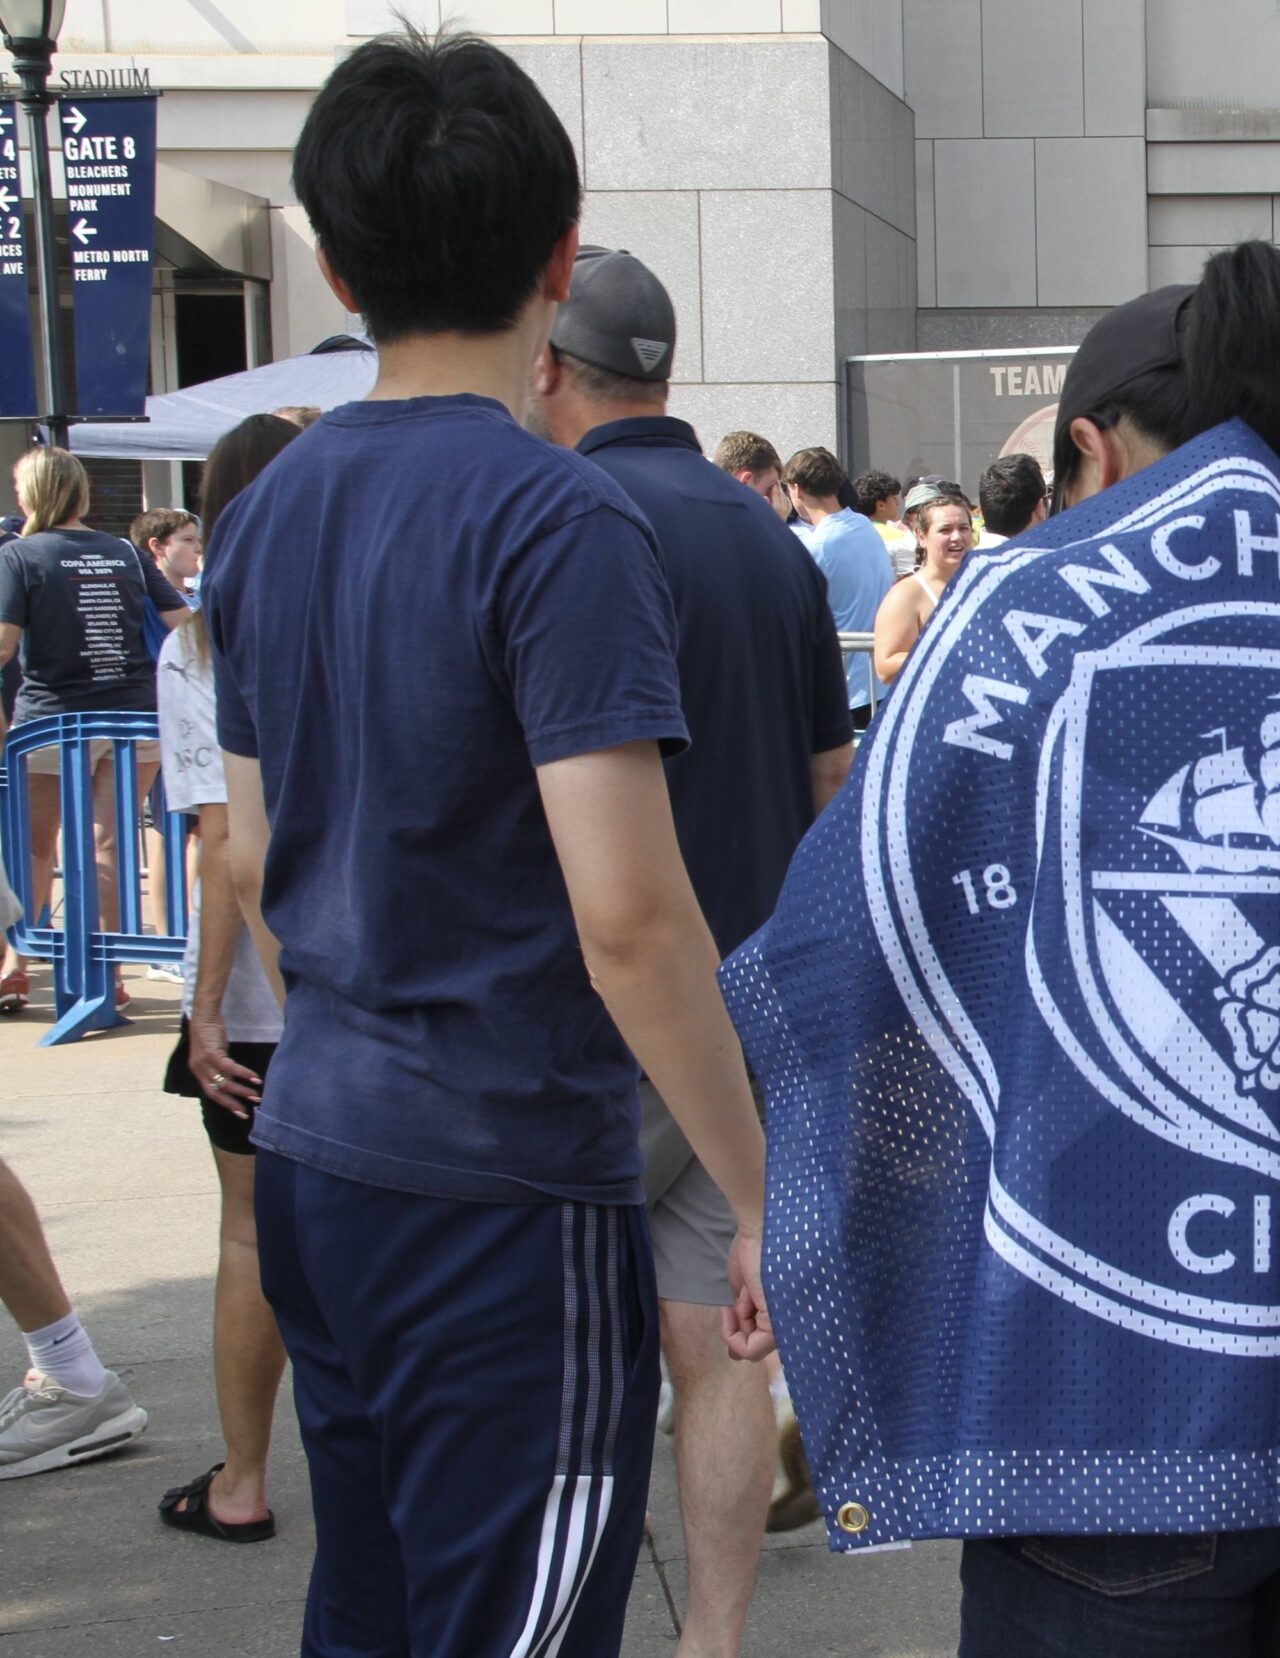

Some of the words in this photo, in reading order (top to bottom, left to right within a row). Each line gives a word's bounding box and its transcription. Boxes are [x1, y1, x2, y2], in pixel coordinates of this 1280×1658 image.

[60, 68, 152, 91] STADIUM
[3, 139, 16, 162] 4
[64, 136, 118, 160] GATE
[123, 136, 136, 160] 8
[67, 165, 128, 178] BLEACHERS
[68, 184, 131, 197] MONUMENT
[69, 199, 98, 211] PARK
[8, 216, 22, 239] 2
[73, 251, 111, 263] METRO
[112, 250, 149, 262] NORTH
[3, 262, 24, 275] AVE
[74, 268, 107, 281] FERRY
[990, 364, 1067, 396] TEAM
[951, 863, 1018, 915] 18
